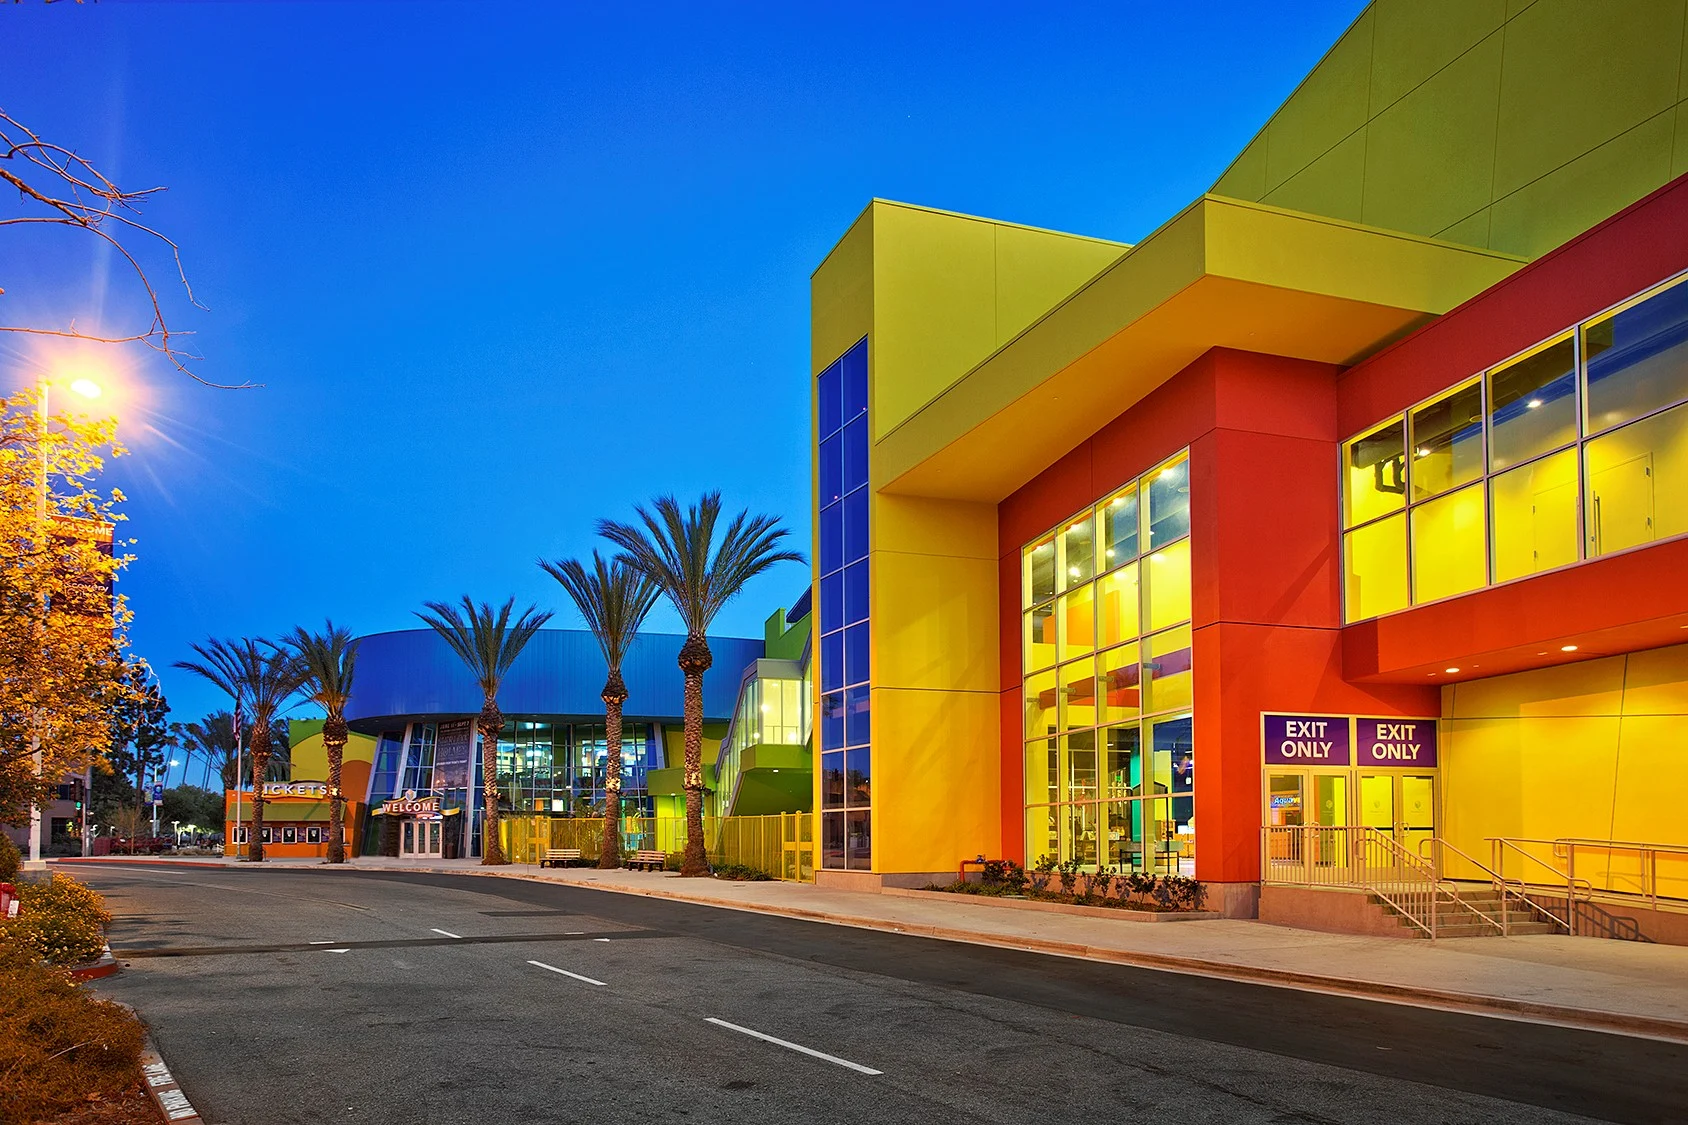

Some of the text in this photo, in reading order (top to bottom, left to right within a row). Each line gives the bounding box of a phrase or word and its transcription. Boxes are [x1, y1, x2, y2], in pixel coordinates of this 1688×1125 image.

[1285, 720, 1328, 739] EXIT
[1376, 723, 1416, 741] EXIT
[1280, 740, 1333, 758] ONLY
[1371, 742, 1421, 760] ONLY
[263, 785, 327, 795] ICKETS
[381, 802, 440, 812] WELCOME
